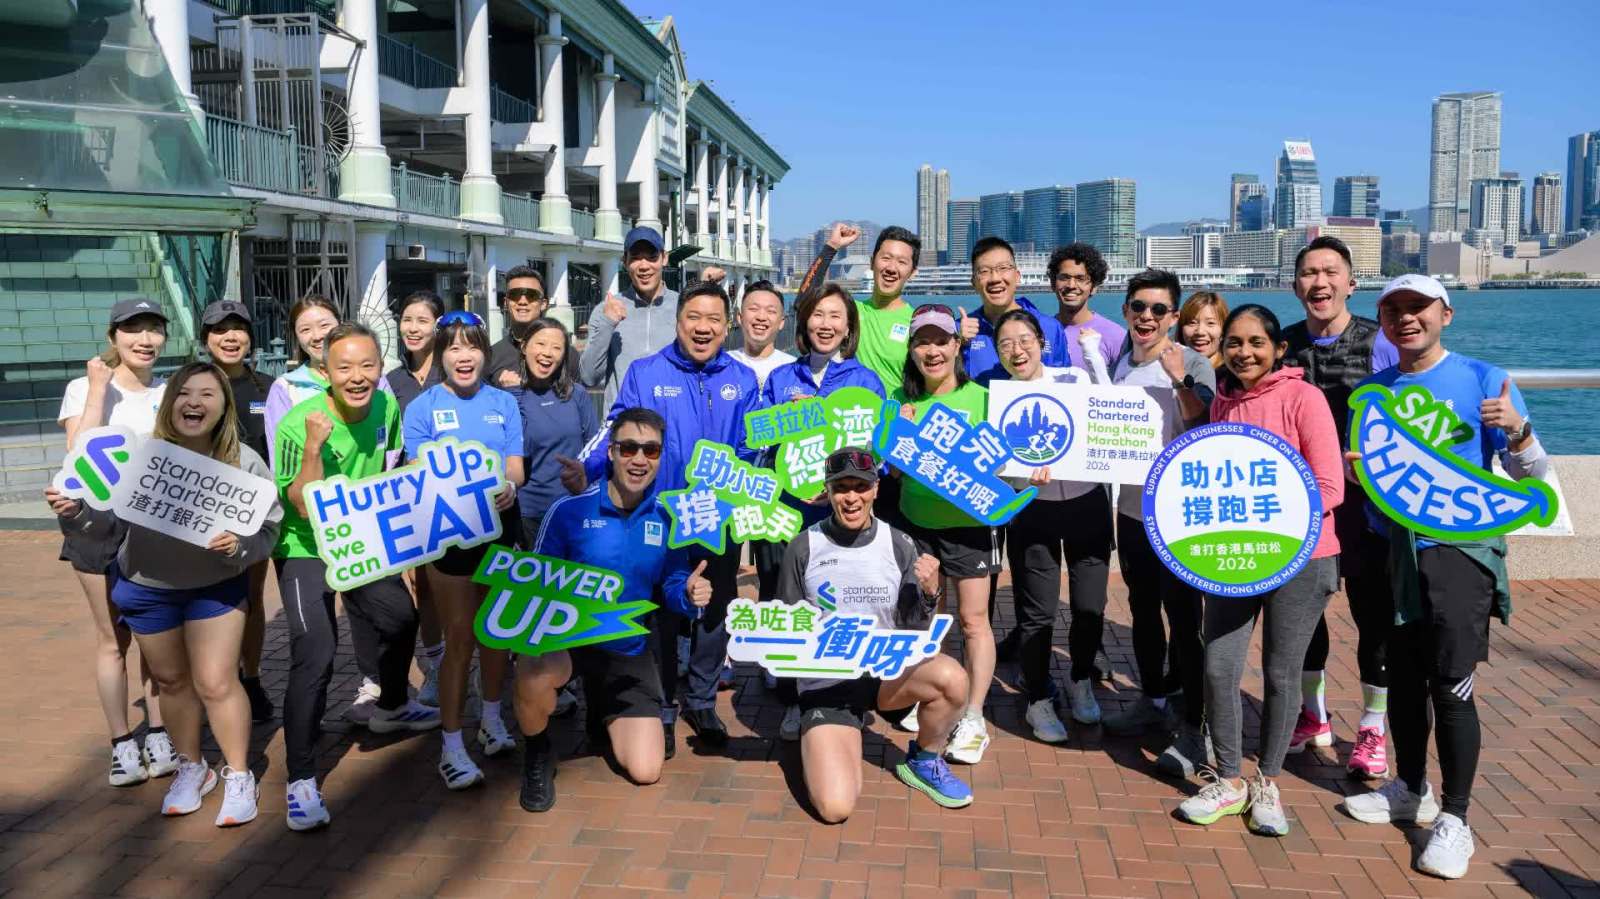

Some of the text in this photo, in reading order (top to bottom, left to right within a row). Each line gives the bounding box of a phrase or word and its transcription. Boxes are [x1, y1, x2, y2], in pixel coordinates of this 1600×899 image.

[752, 401, 827, 442] 馬拉松
[1088, 397, 1145, 410] Standard
[1088, 409, 1149, 422] Chartered
[1395, 392, 1464, 448] SAY
[784, 404, 876, 489] 經濟
[919, 409, 1007, 473] 跑完
[1087, 422, 1155, 438] Hong Kong
[1087, 435, 1148, 448] Marathon
[147, 456, 258, 505] standard
[692, 446, 777, 505] 助小店
[890, 436, 999, 516] 食餐好嘅
[1086, 461, 1110, 471] 2026
[1146, 425, 1244, 496] SUPPORT SMALL BUSINESSES
[1180, 458, 1278, 489] 助小店
[1250, 428, 1317, 492] CHEER ON THE CITY
[1363, 418, 1516, 526] CHEESE
[139, 474, 256, 526] chartered
[313, 446, 493, 523] Hurry Up,
[127, 491, 215, 534] 渣打銀行
[325, 523, 352, 542] so
[376, 476, 498, 565] EAT
[676, 490, 799, 540] 撐跑手
[1182, 493, 1281, 526] 撐跑手
[329, 540, 365, 560] we
[336, 556, 381, 582] can
[1146, 511, 1321, 594] STANDARD CHARTERED HONG KONG MARATHON 2026
[1190, 541, 1281, 556] 渣打香港馬拉松
[1216, 557, 1257, 571] 2026
[486, 551, 622, 603] POWER
[843, 585, 889, 595] standard
[843, 595, 890, 603] chartered
[485, 589, 579, 645] UP
[731, 604, 816, 632] 為咗食
[813, 616, 949, 676] 衝呀!
